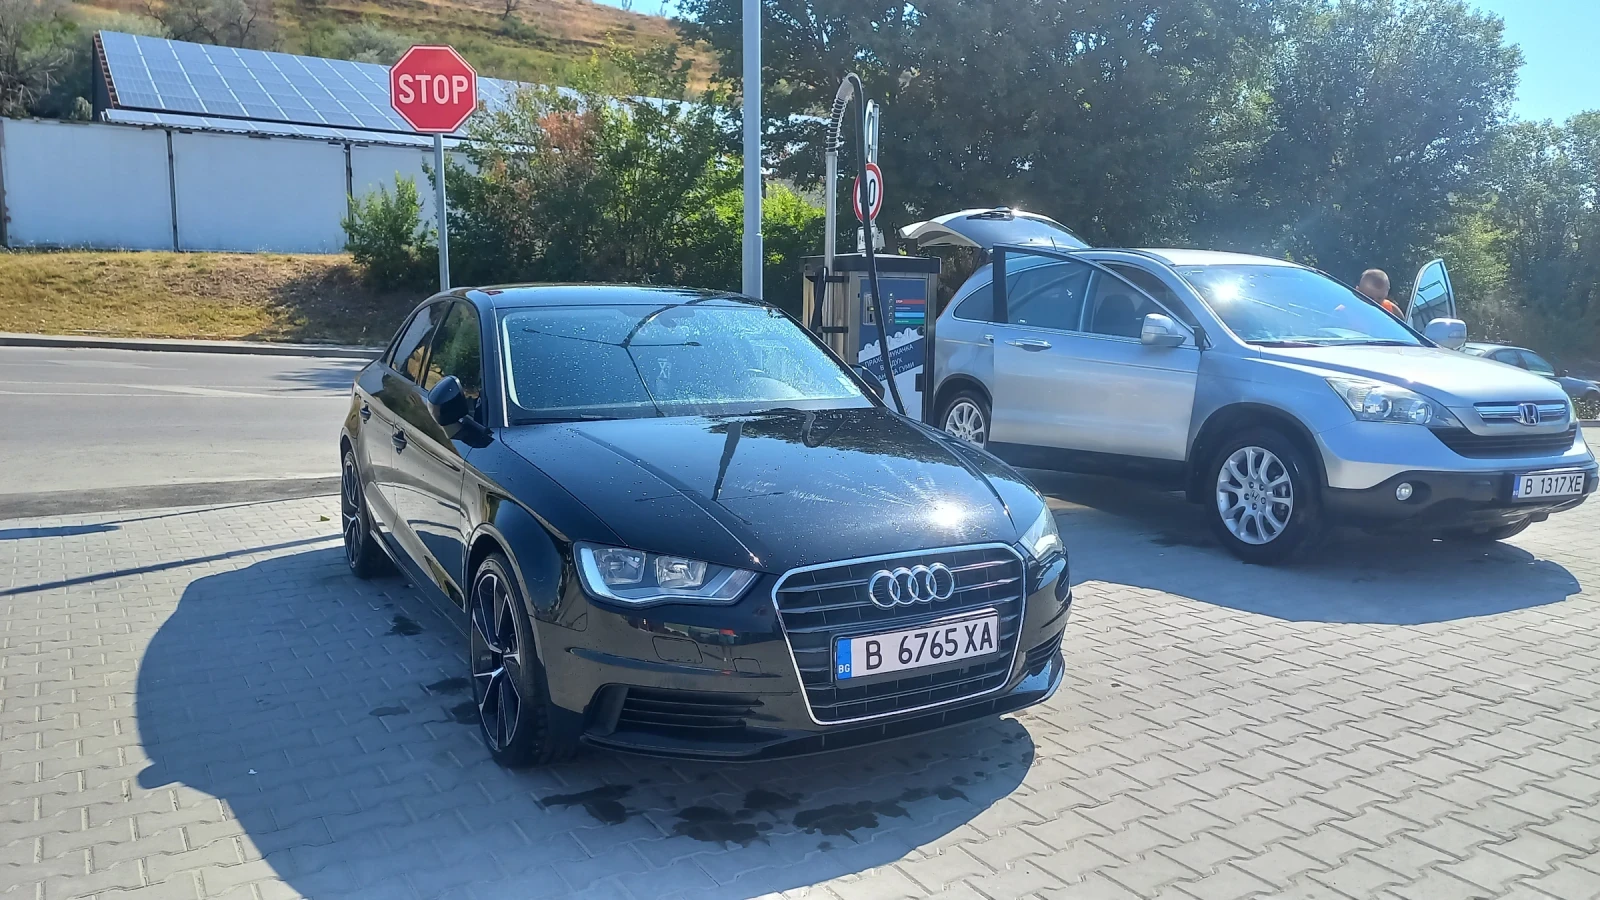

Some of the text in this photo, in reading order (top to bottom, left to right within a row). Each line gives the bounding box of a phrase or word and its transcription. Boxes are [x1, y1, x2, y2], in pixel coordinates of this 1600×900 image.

[398, 74, 469, 105] STOP
[880, 357, 903, 372] ВДУХ
[898, 361, 915, 373] ГУМИ
[1524, 475, 1582, 495] B 1317 XE
[865, 621, 994, 670] B 6765 XA
[838, 663, 851, 674] BG
